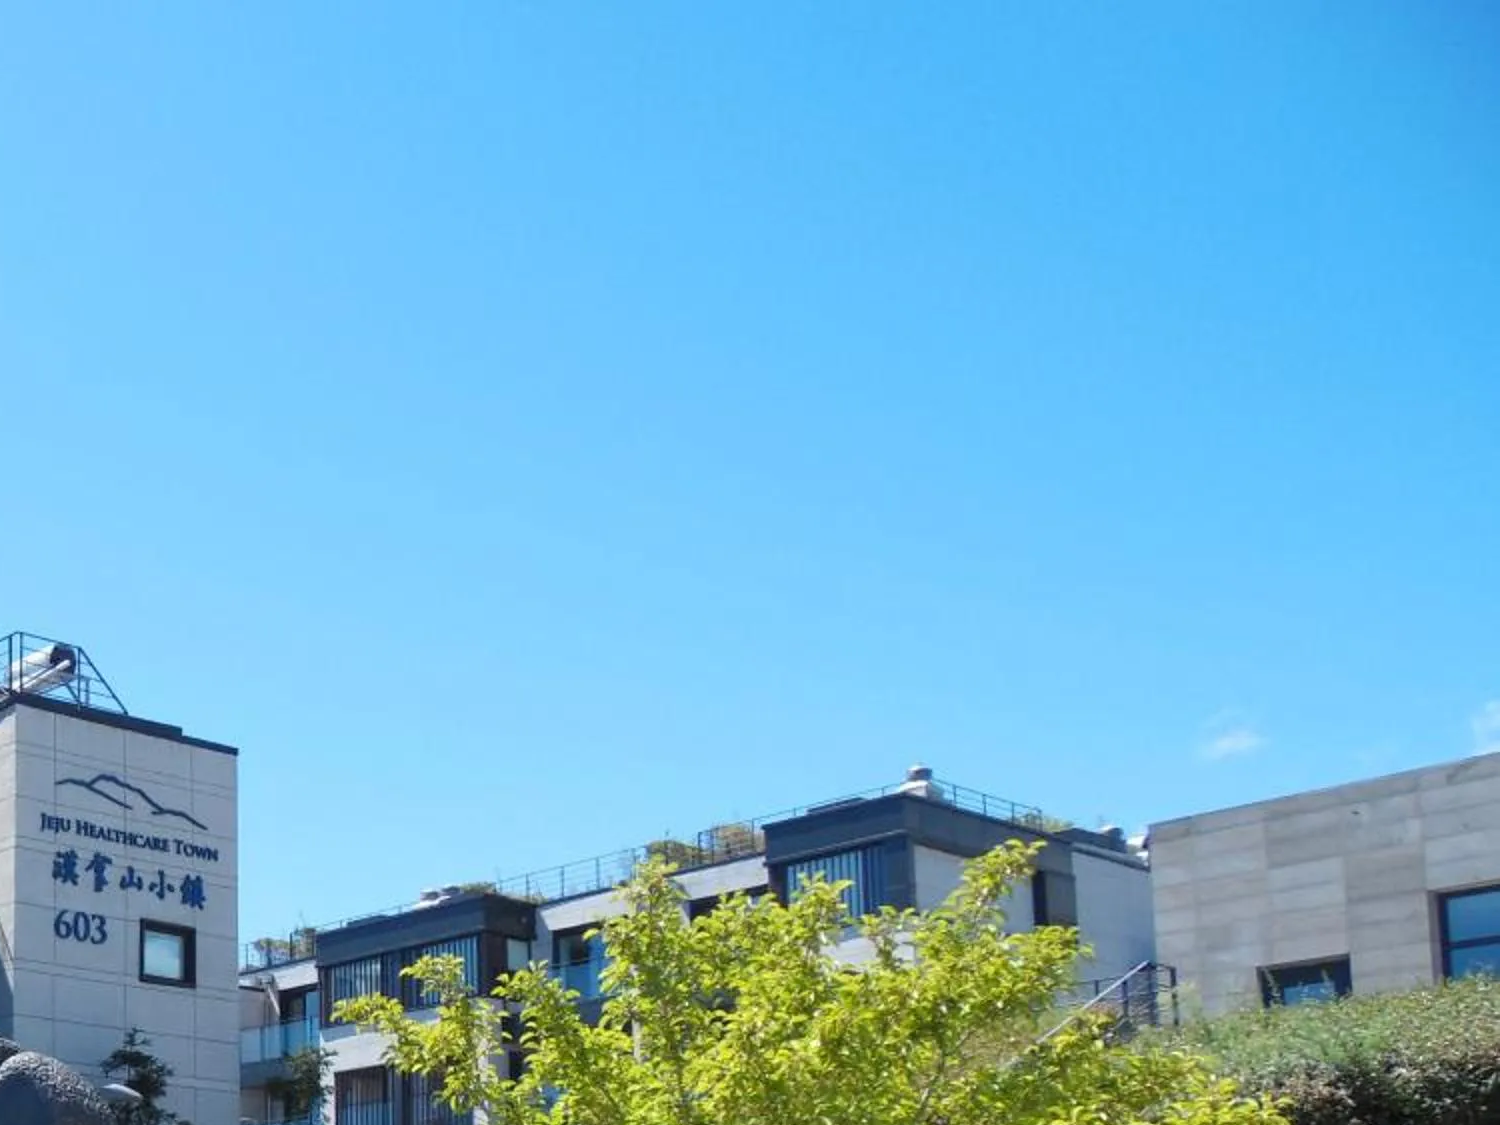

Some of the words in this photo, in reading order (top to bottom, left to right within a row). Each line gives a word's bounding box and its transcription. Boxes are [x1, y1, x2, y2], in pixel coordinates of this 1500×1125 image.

[40, 812, 71, 832] JEJU
[76, 820, 169, 851] HEALTHCARE
[173, 839, 219, 862] TOWN
[54, 909, 108, 945] 603
